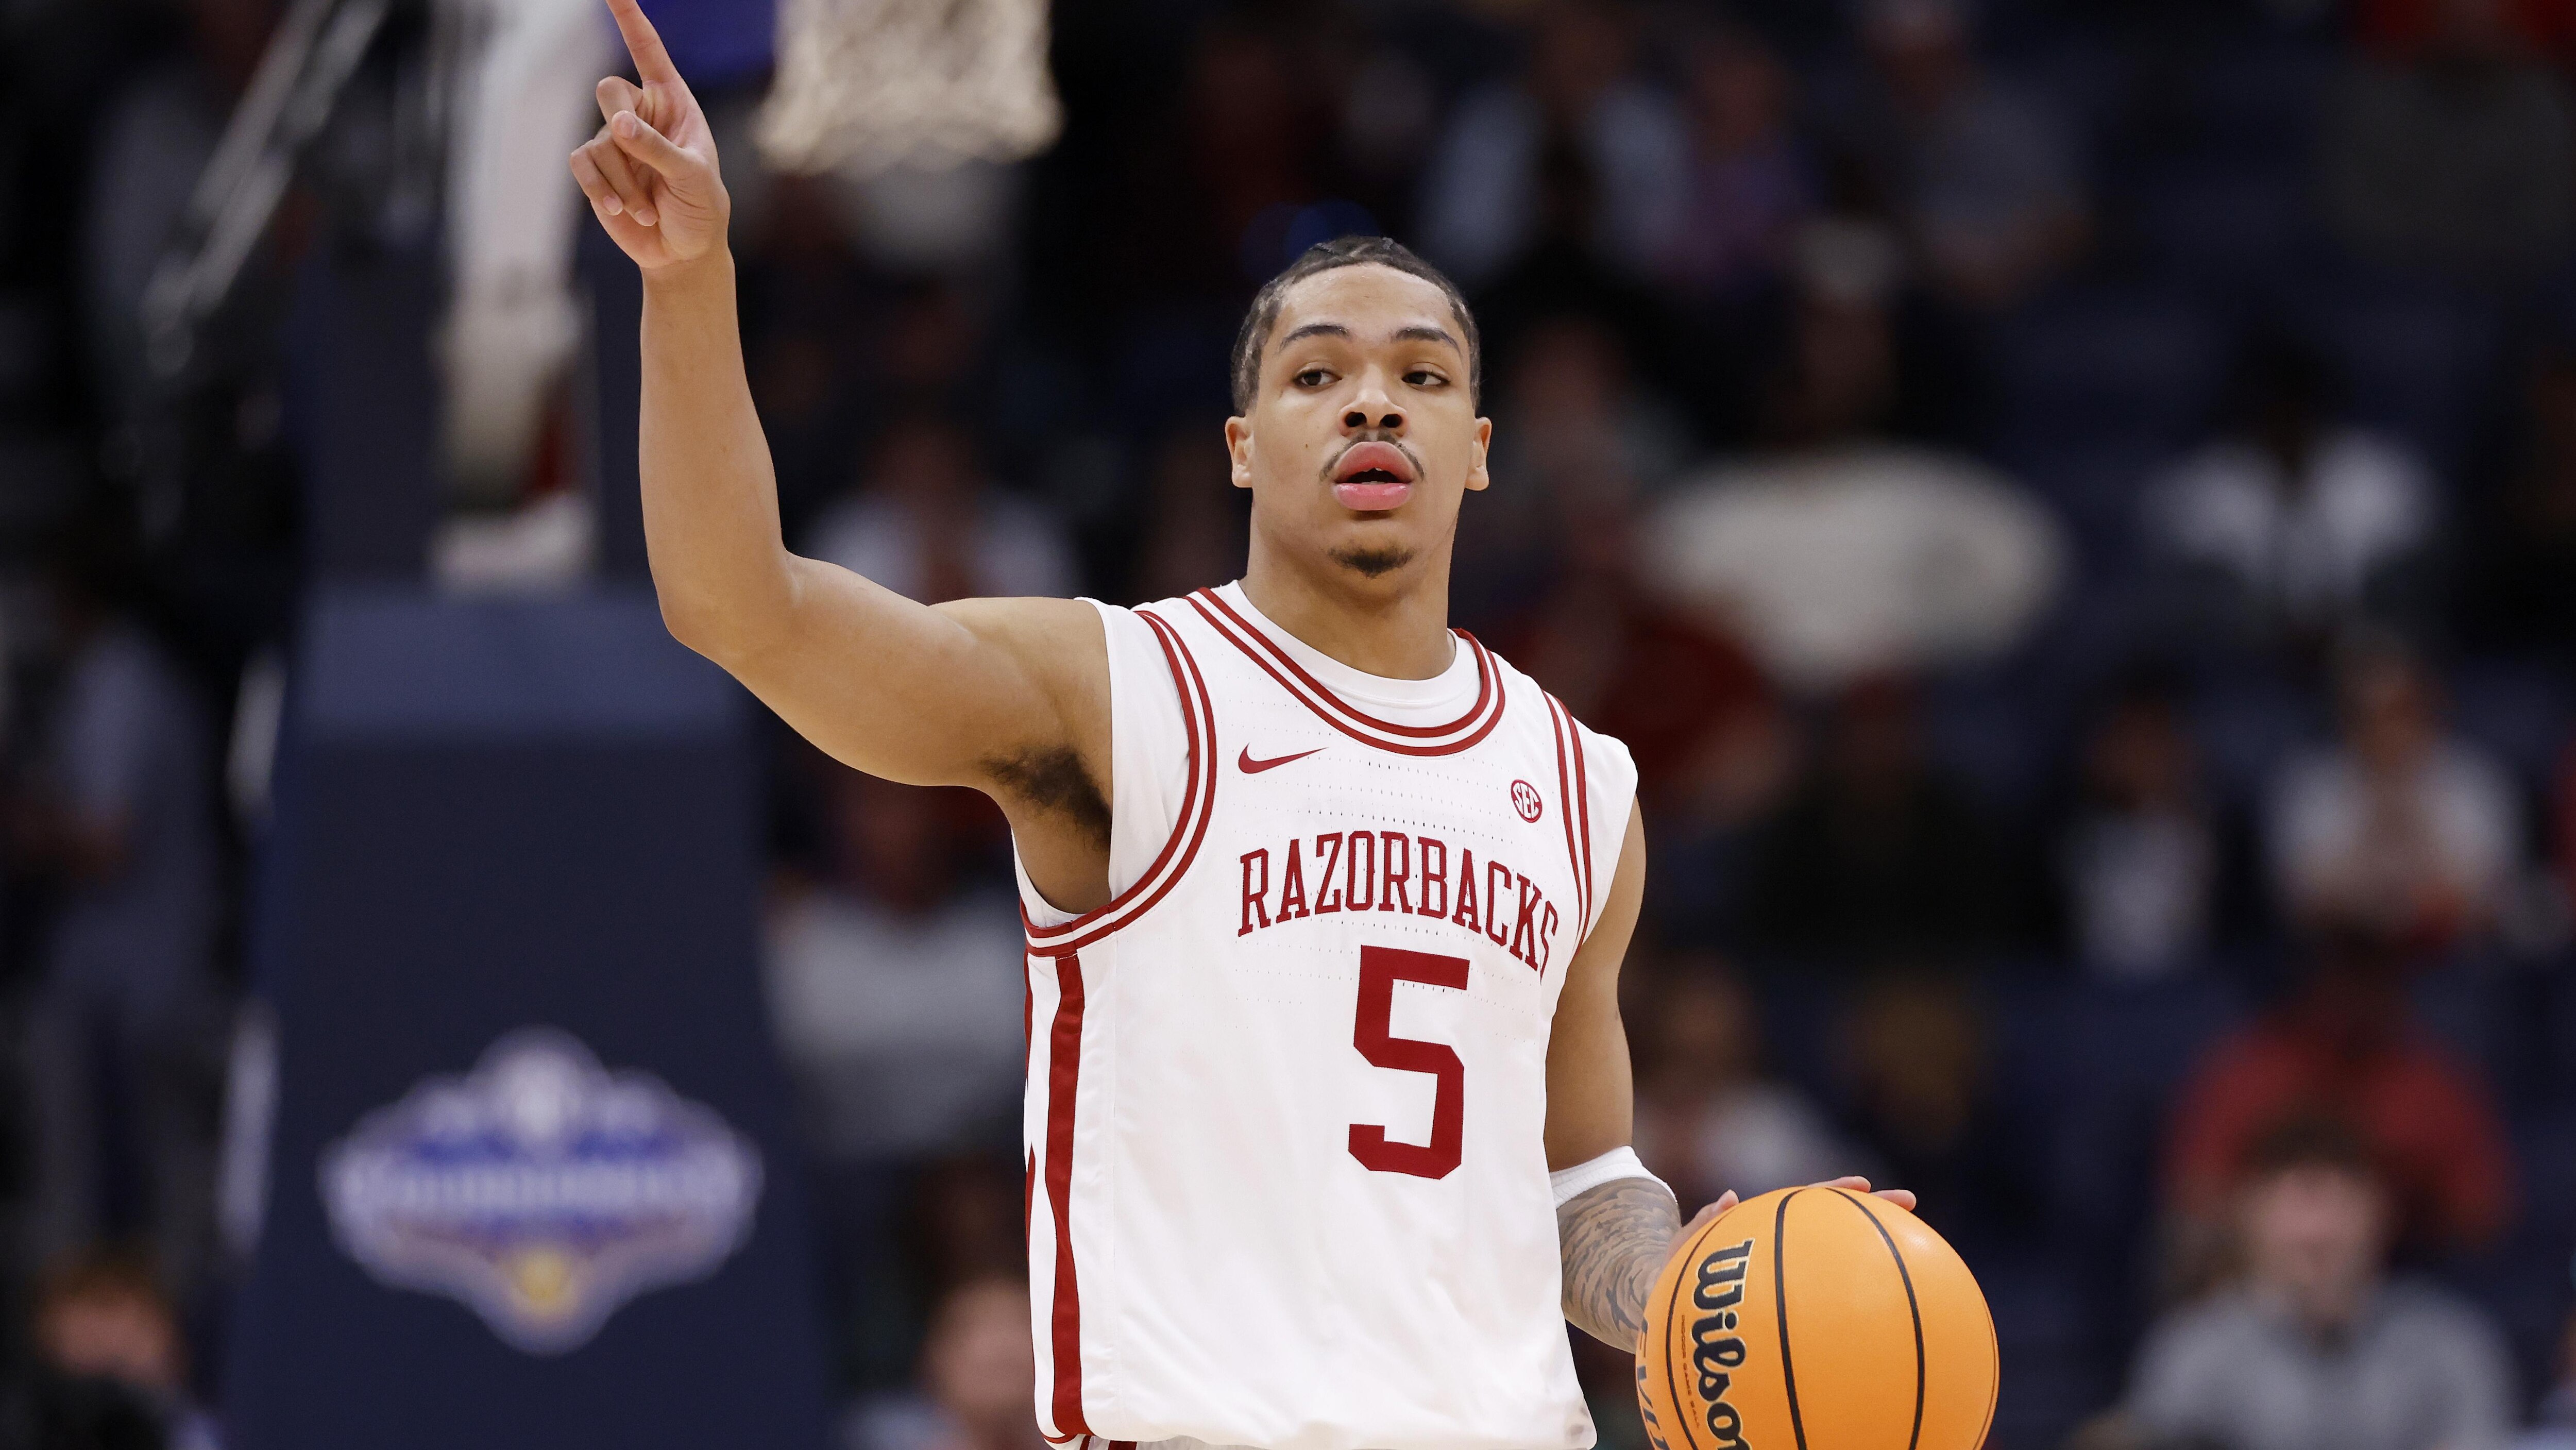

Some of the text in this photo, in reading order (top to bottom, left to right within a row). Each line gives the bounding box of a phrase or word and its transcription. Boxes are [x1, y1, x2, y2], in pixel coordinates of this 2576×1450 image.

[1513, 782, 1540, 819] SEC
[1238, 830, 1558, 984] RAZORBACKS
[1348, 945, 1470, 1180] 5
[1683, 1362, 1692, 1396] GAME
[1690, 1400, 1700, 1429] BALL
